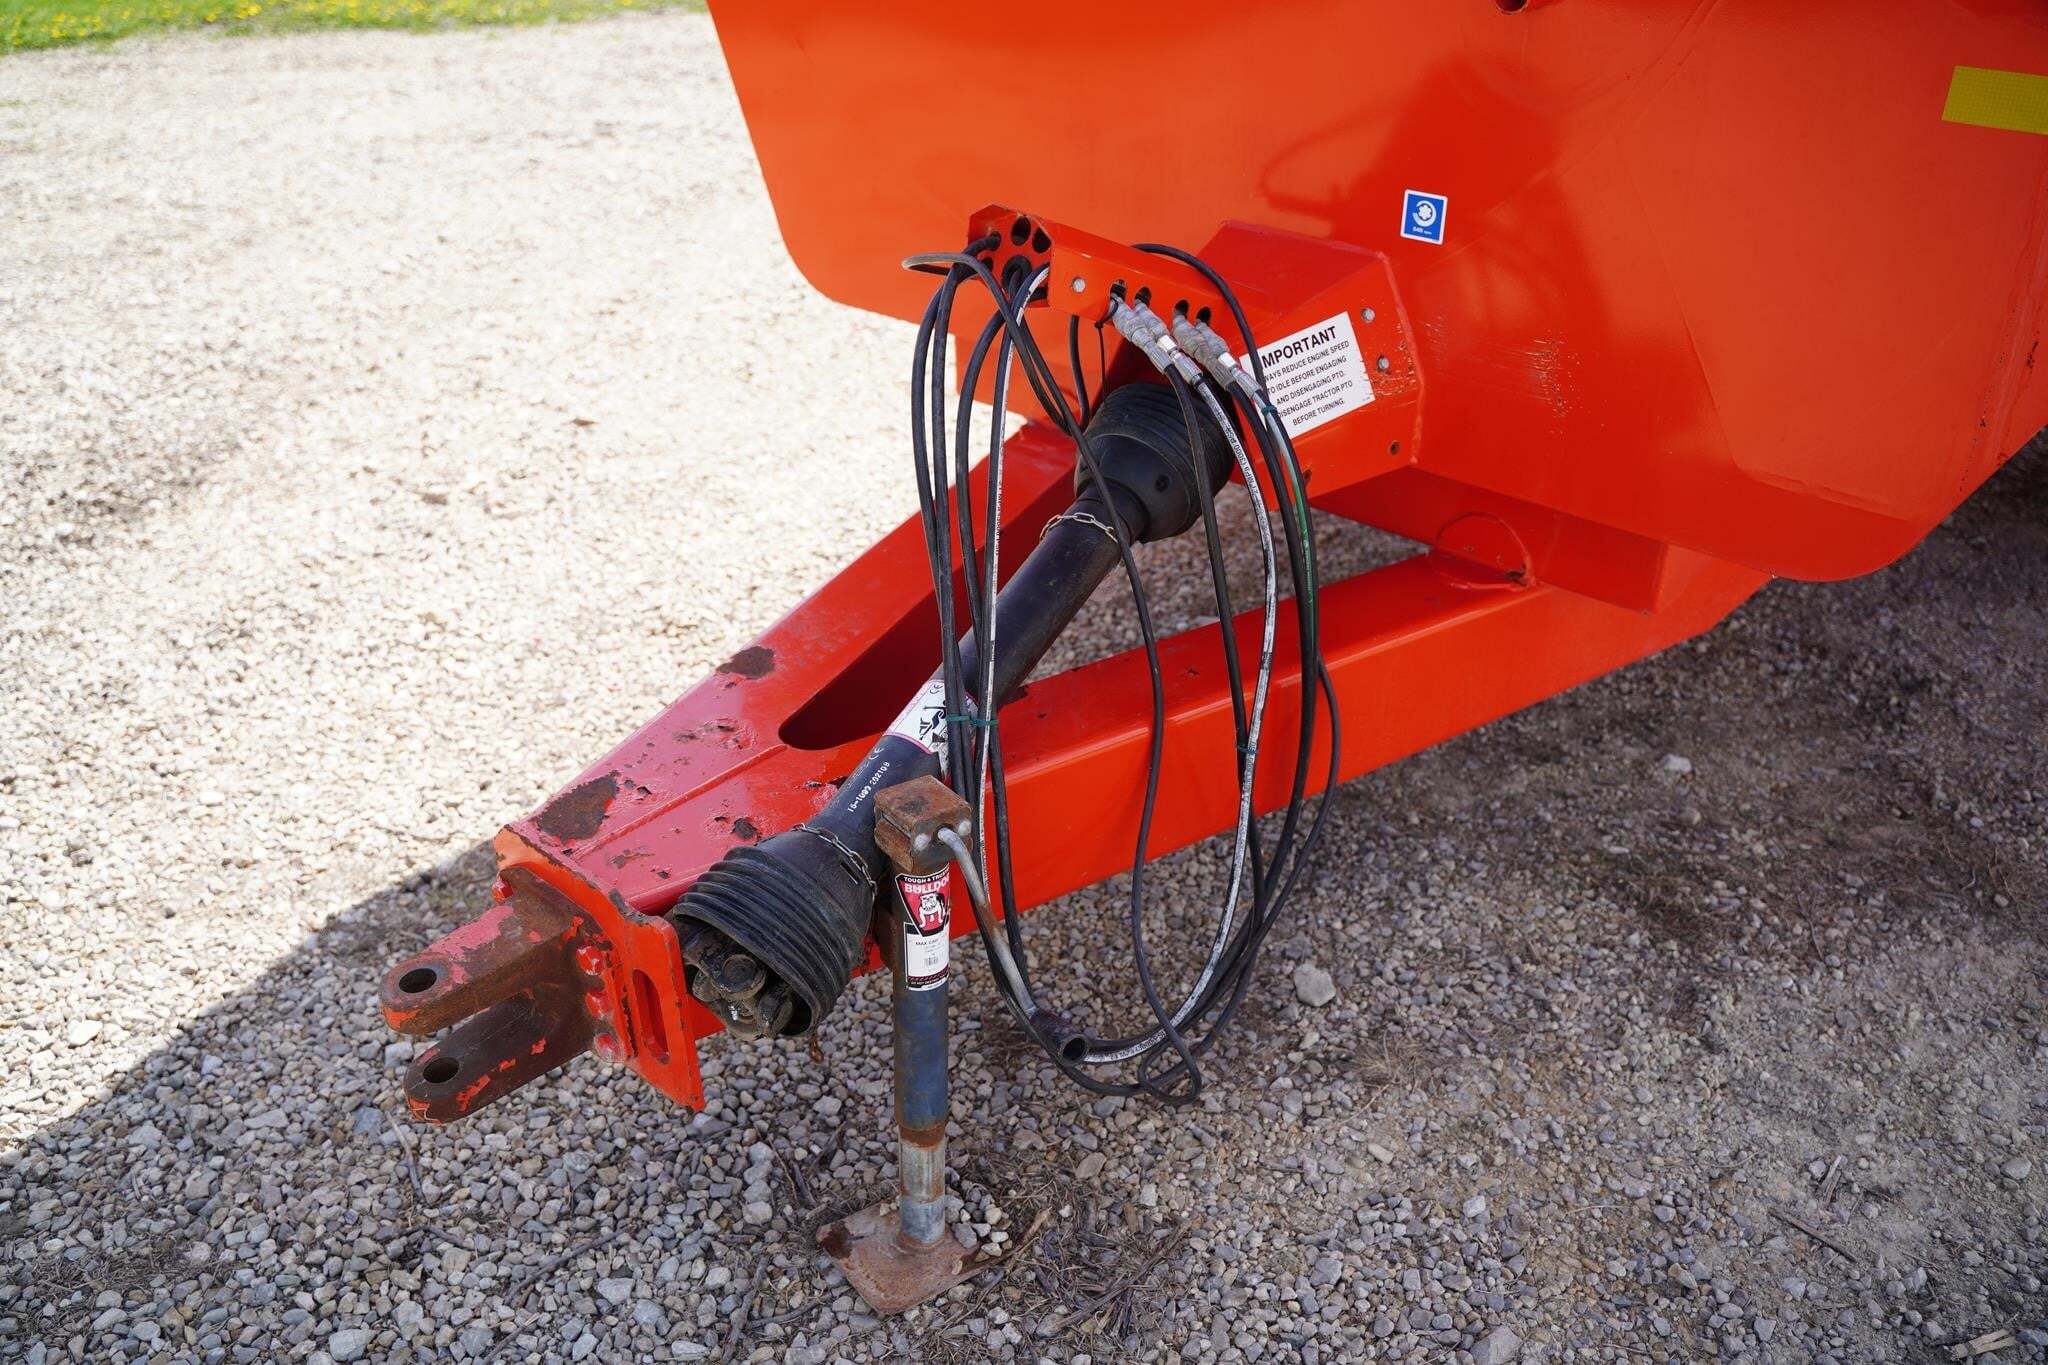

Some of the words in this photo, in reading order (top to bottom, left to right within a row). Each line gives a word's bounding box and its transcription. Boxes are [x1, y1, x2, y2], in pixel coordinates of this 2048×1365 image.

[1262, 326, 1336, 368] MPORTANT
[1282, 359, 1307, 374] REDUCE
[1307, 348, 1330, 364] ENGINE
[1330, 340, 1350, 354] SPEED
[1267, 386, 1276, 395] TO
[1276, 379, 1290, 392] IDLE
[1291, 368, 1315, 384] BEFORE
[1315, 355, 1347, 374] ENGAGING
[1276, 393, 1290, 405] AND
[1290, 376, 1332, 399] DISENGAGING
[1312, 385, 1340, 403] TRACTOR
[1292, 409, 1318, 426] BEFORE
